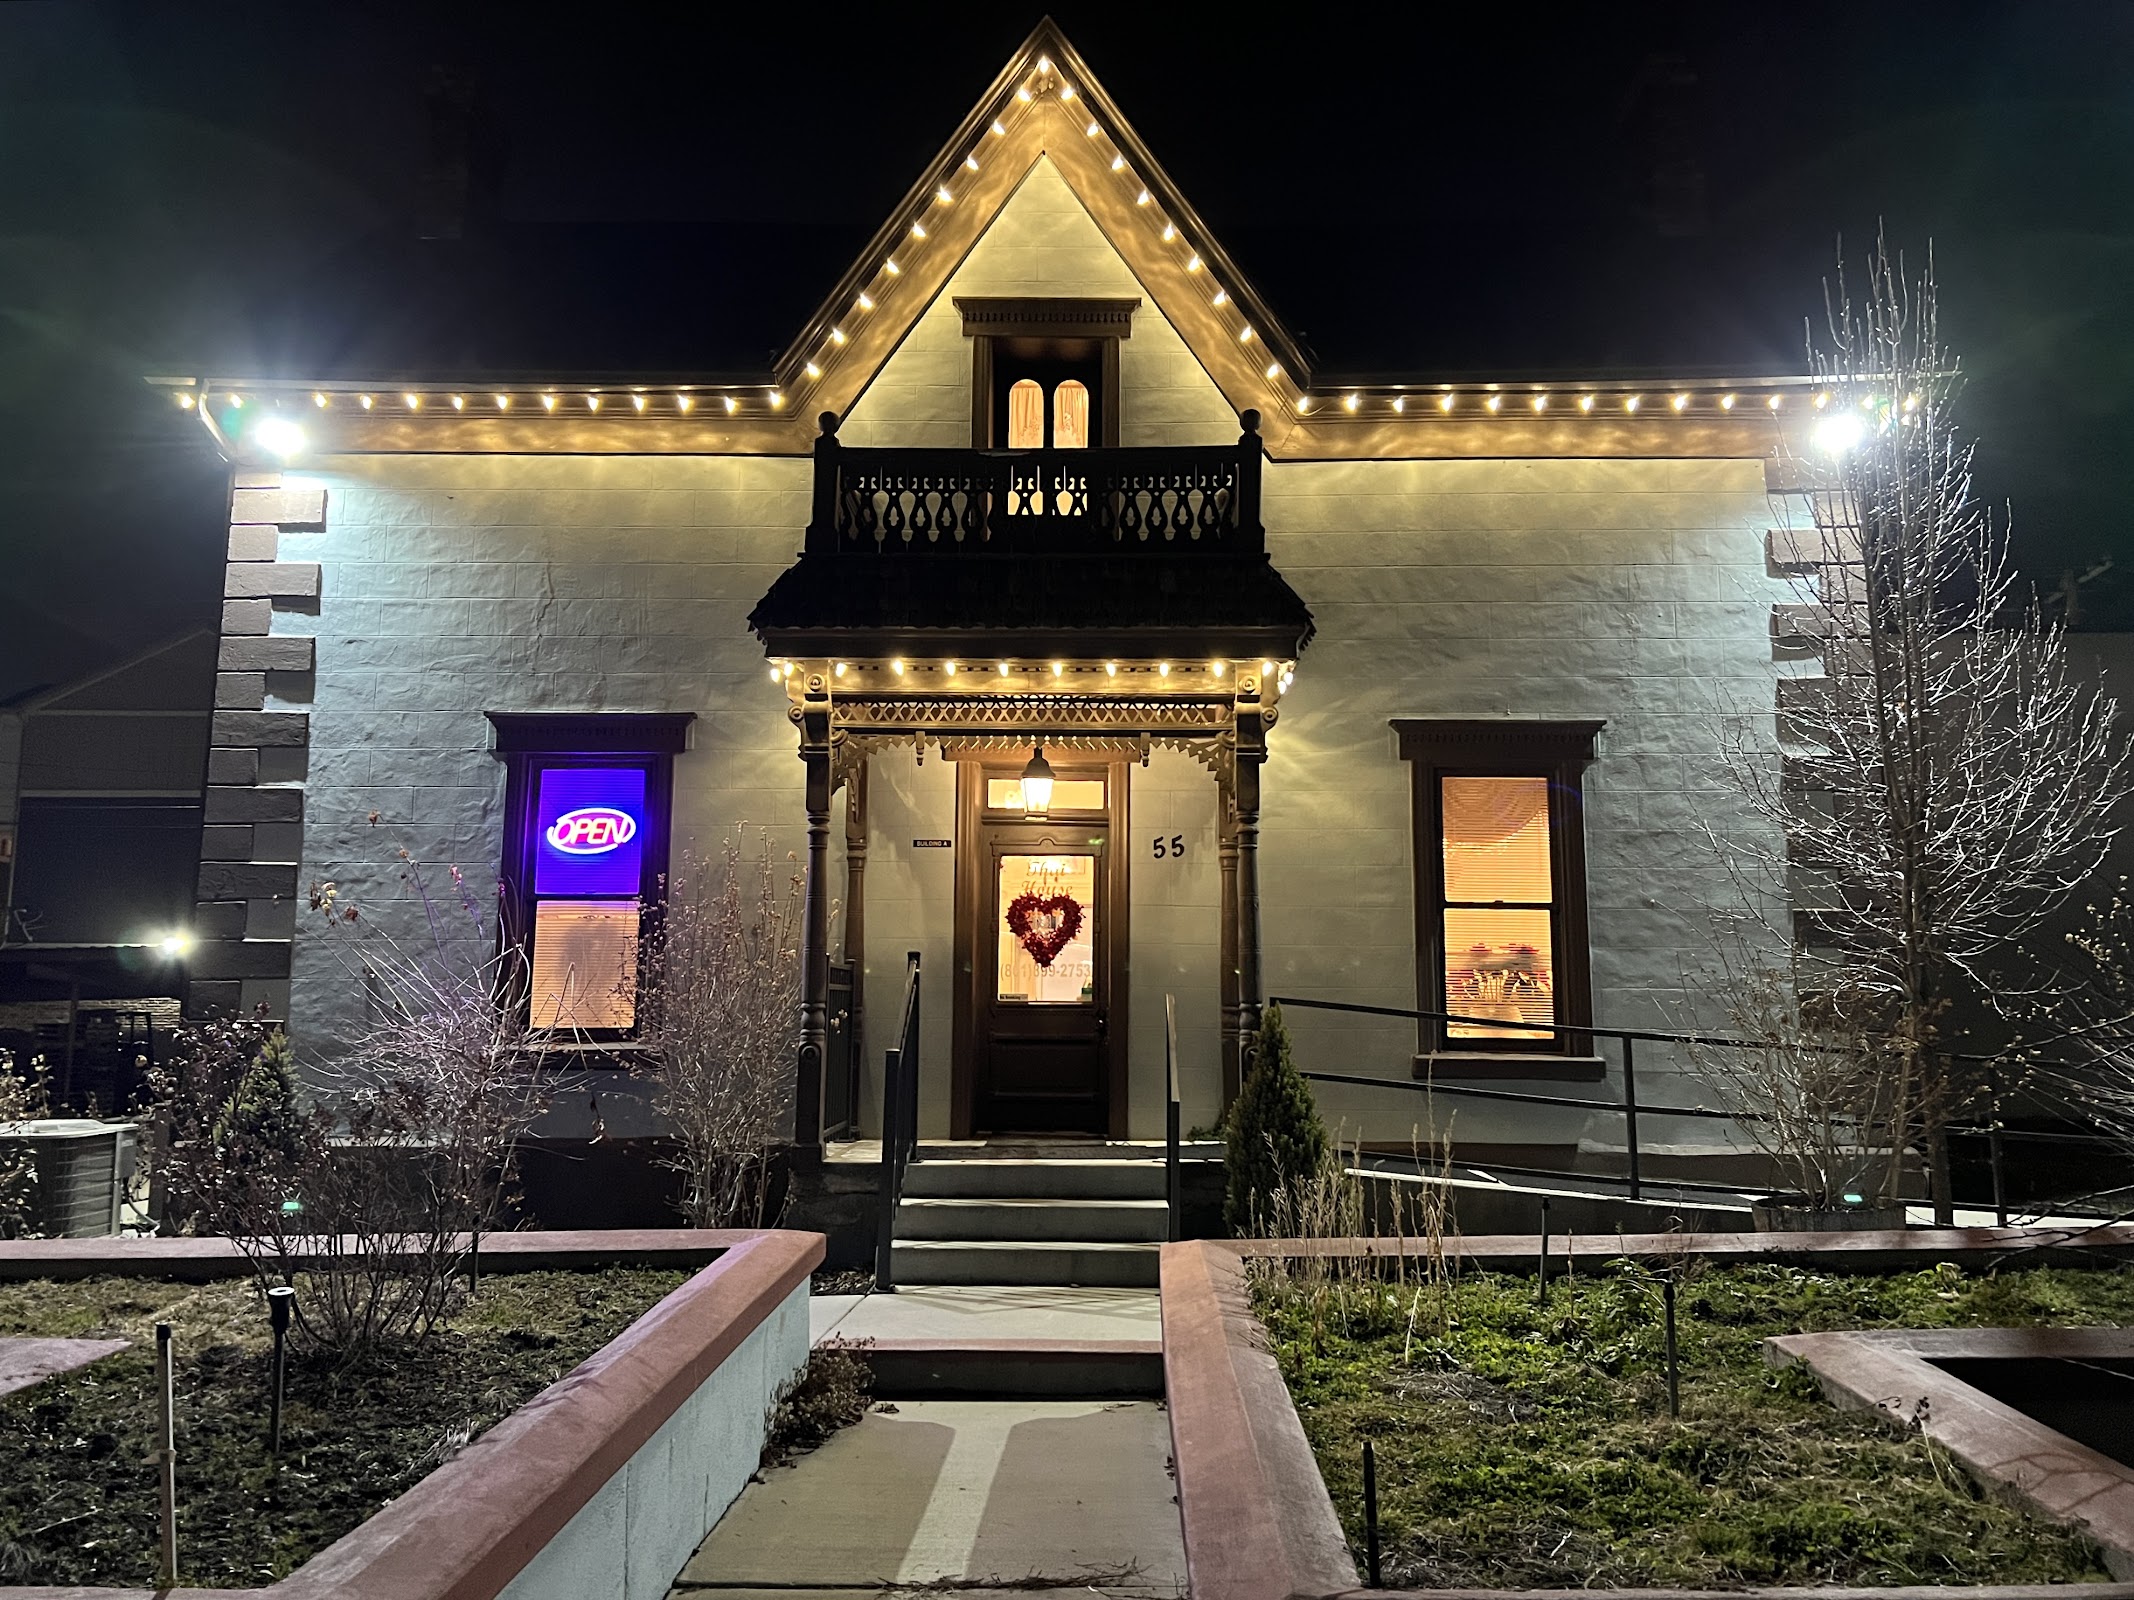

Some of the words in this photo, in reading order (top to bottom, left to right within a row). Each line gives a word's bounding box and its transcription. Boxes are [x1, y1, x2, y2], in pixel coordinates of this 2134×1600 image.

[553, 818, 629, 844] OPEN
[1153, 834, 1185, 859] 55
[1021, 880, 1073, 896] House
